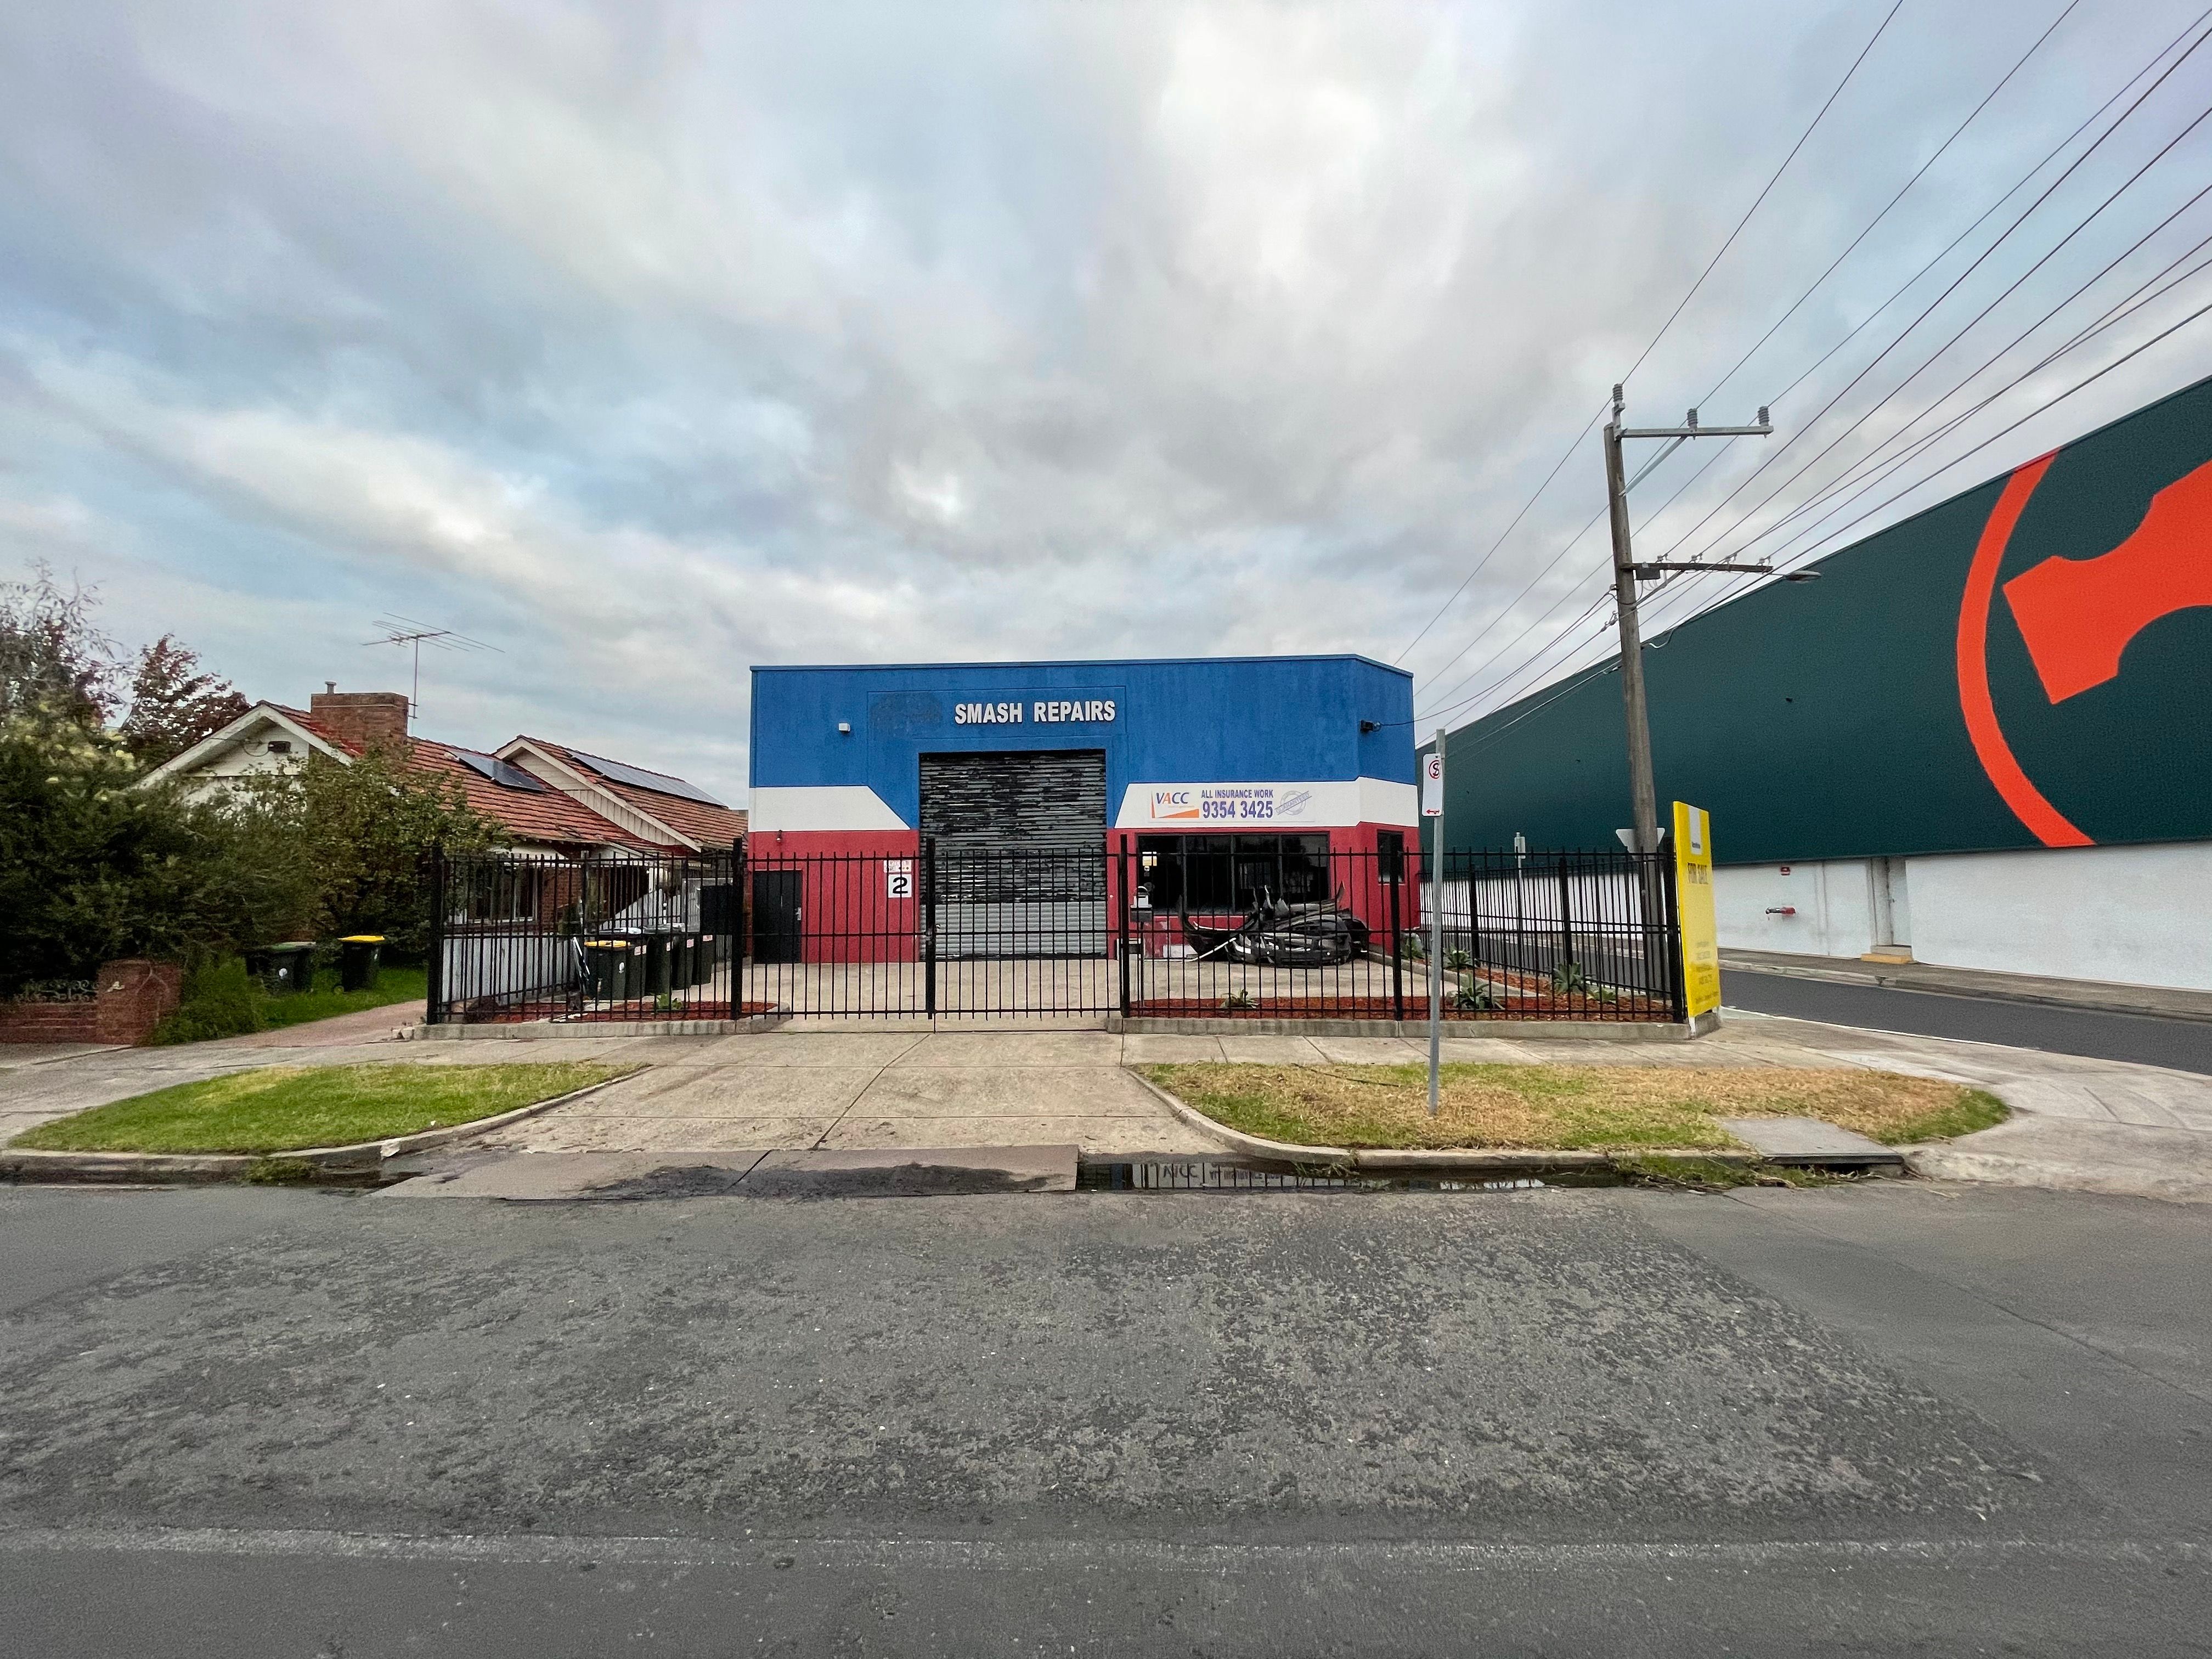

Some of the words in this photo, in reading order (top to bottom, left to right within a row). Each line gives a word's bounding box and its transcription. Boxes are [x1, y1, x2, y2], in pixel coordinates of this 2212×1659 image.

[955, 702, 1023, 724] SMASH
[1034, 700, 1115, 722] REPAIRS
[1156, 792, 1189, 804] VACC
[1201, 790, 1213, 799] ALL
[1215, 789, 1252, 799] INSURANCE
[1254, 789, 1274, 798] WORK
[1203, 800, 1235, 819] 9354
[1240, 800, 1273, 818] 3425
[893, 877, 909, 894] 2
